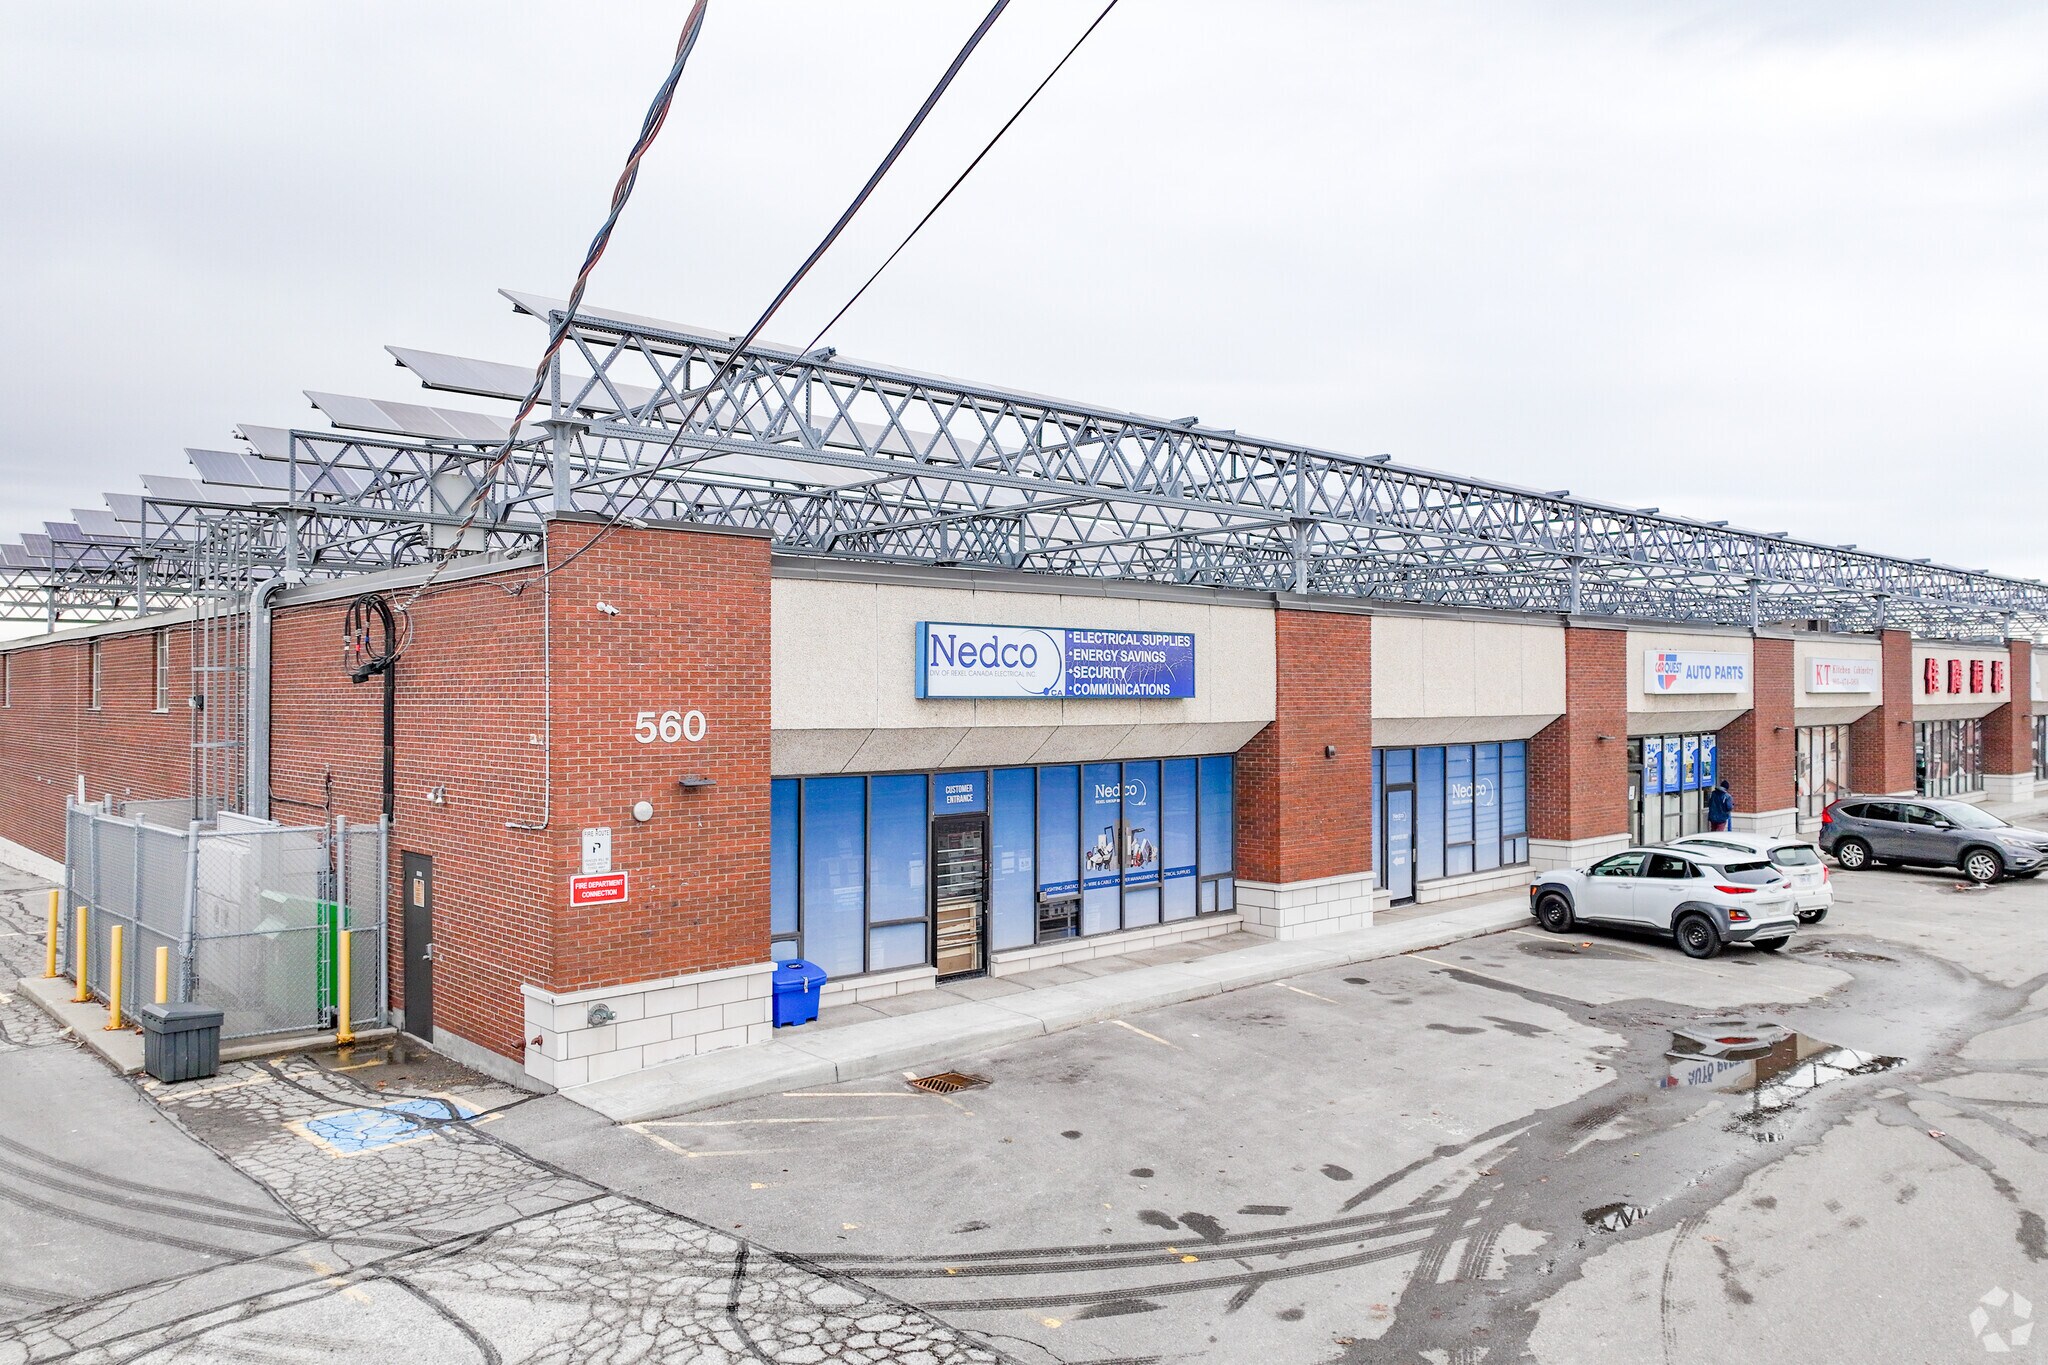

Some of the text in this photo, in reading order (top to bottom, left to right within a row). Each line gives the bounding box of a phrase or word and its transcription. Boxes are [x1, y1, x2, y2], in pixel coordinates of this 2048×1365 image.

[1073, 631, 1191, 647] ELECTRICAL SUPPLIES
[930, 634, 1038, 669] Nedco
[1073, 649, 1166, 663] ENERGY SAVINGS
[994, 670, 1025, 678] ELECTRICAL
[1073, 666, 1127, 679] SECURITY
[1686, 665, 1744, 679] AUTO PARTS
[1816, 664, 1831, 685] KT
[1073, 683, 1171, 695] COMMUNICATIONS
[633, 709, 707, 744] 560
[945, 784, 973, 794] CUSTOMER
[1095, 782, 1137, 798] Nedco
[1452, 782, 1487, 799] Nedco
[946, 794, 974, 804] ENTRANCE
[575, 879, 624, 890] FIRE DEPARTMENT
[581, 889, 618, 899] CONNECTION
